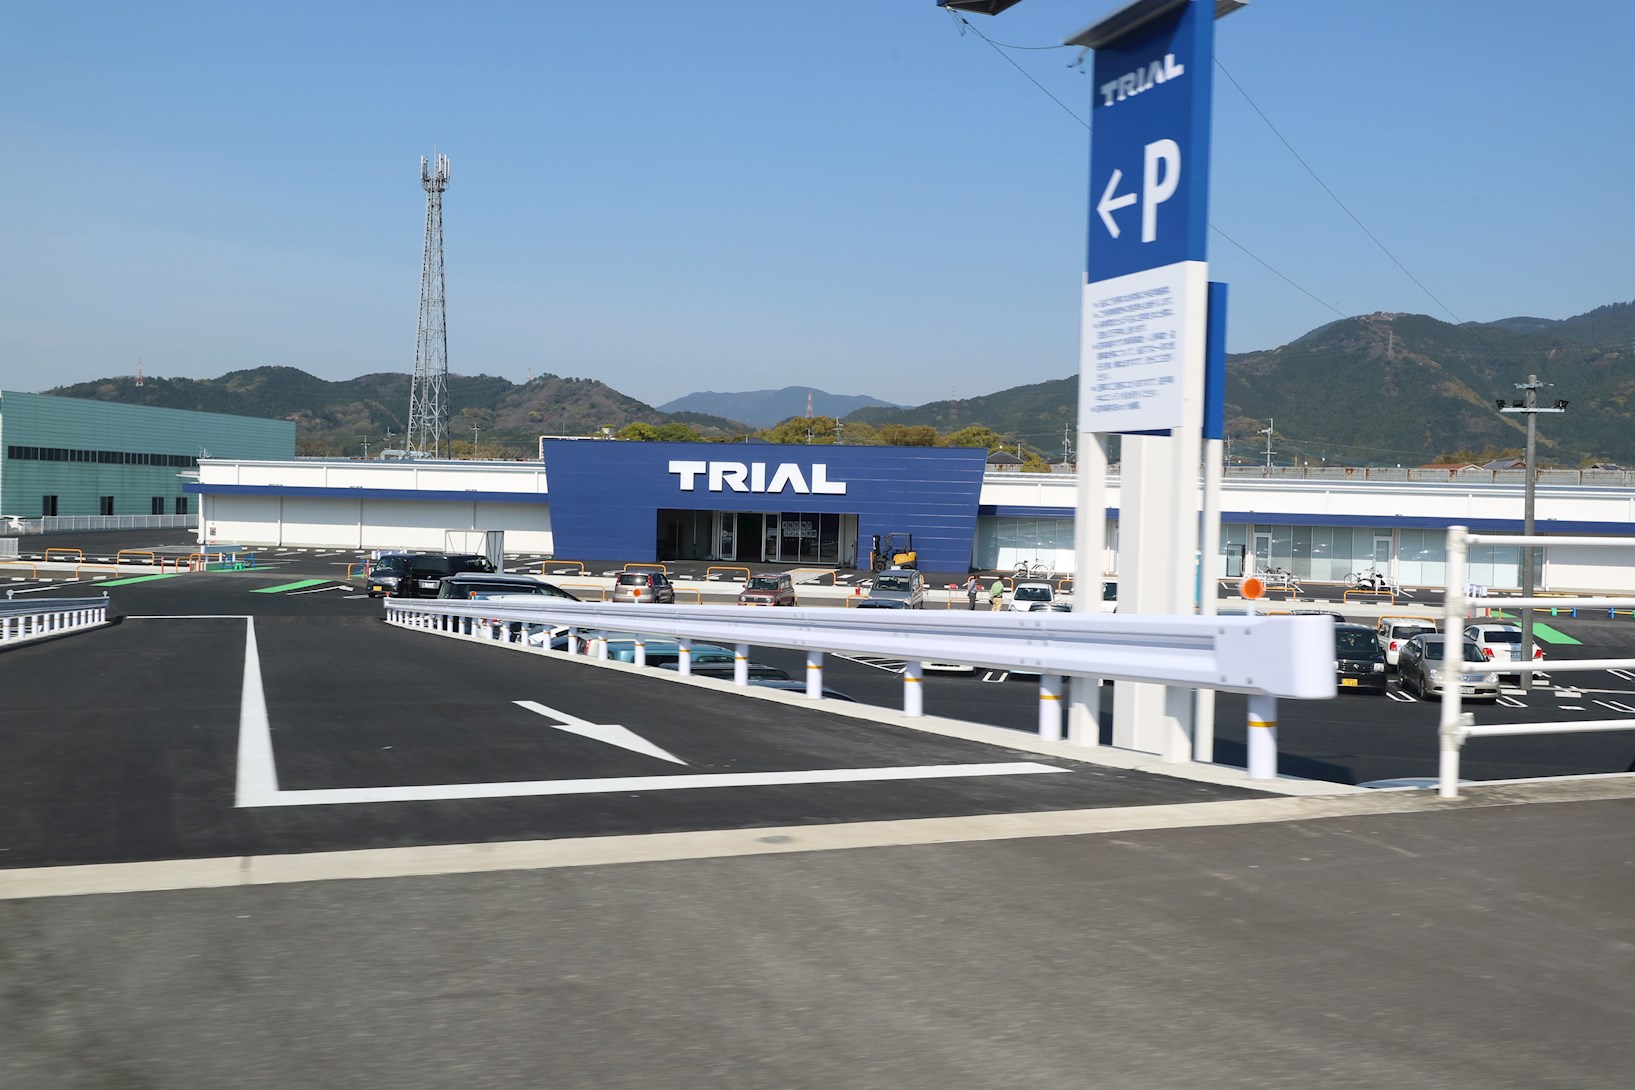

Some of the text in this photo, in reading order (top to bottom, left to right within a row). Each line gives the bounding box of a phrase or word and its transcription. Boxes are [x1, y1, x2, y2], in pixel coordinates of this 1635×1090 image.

[1100, 53, 1185, 107] TRIAL
[1141, 138, 1181, 243] P
[668, 460, 847, 495] TRIAL
